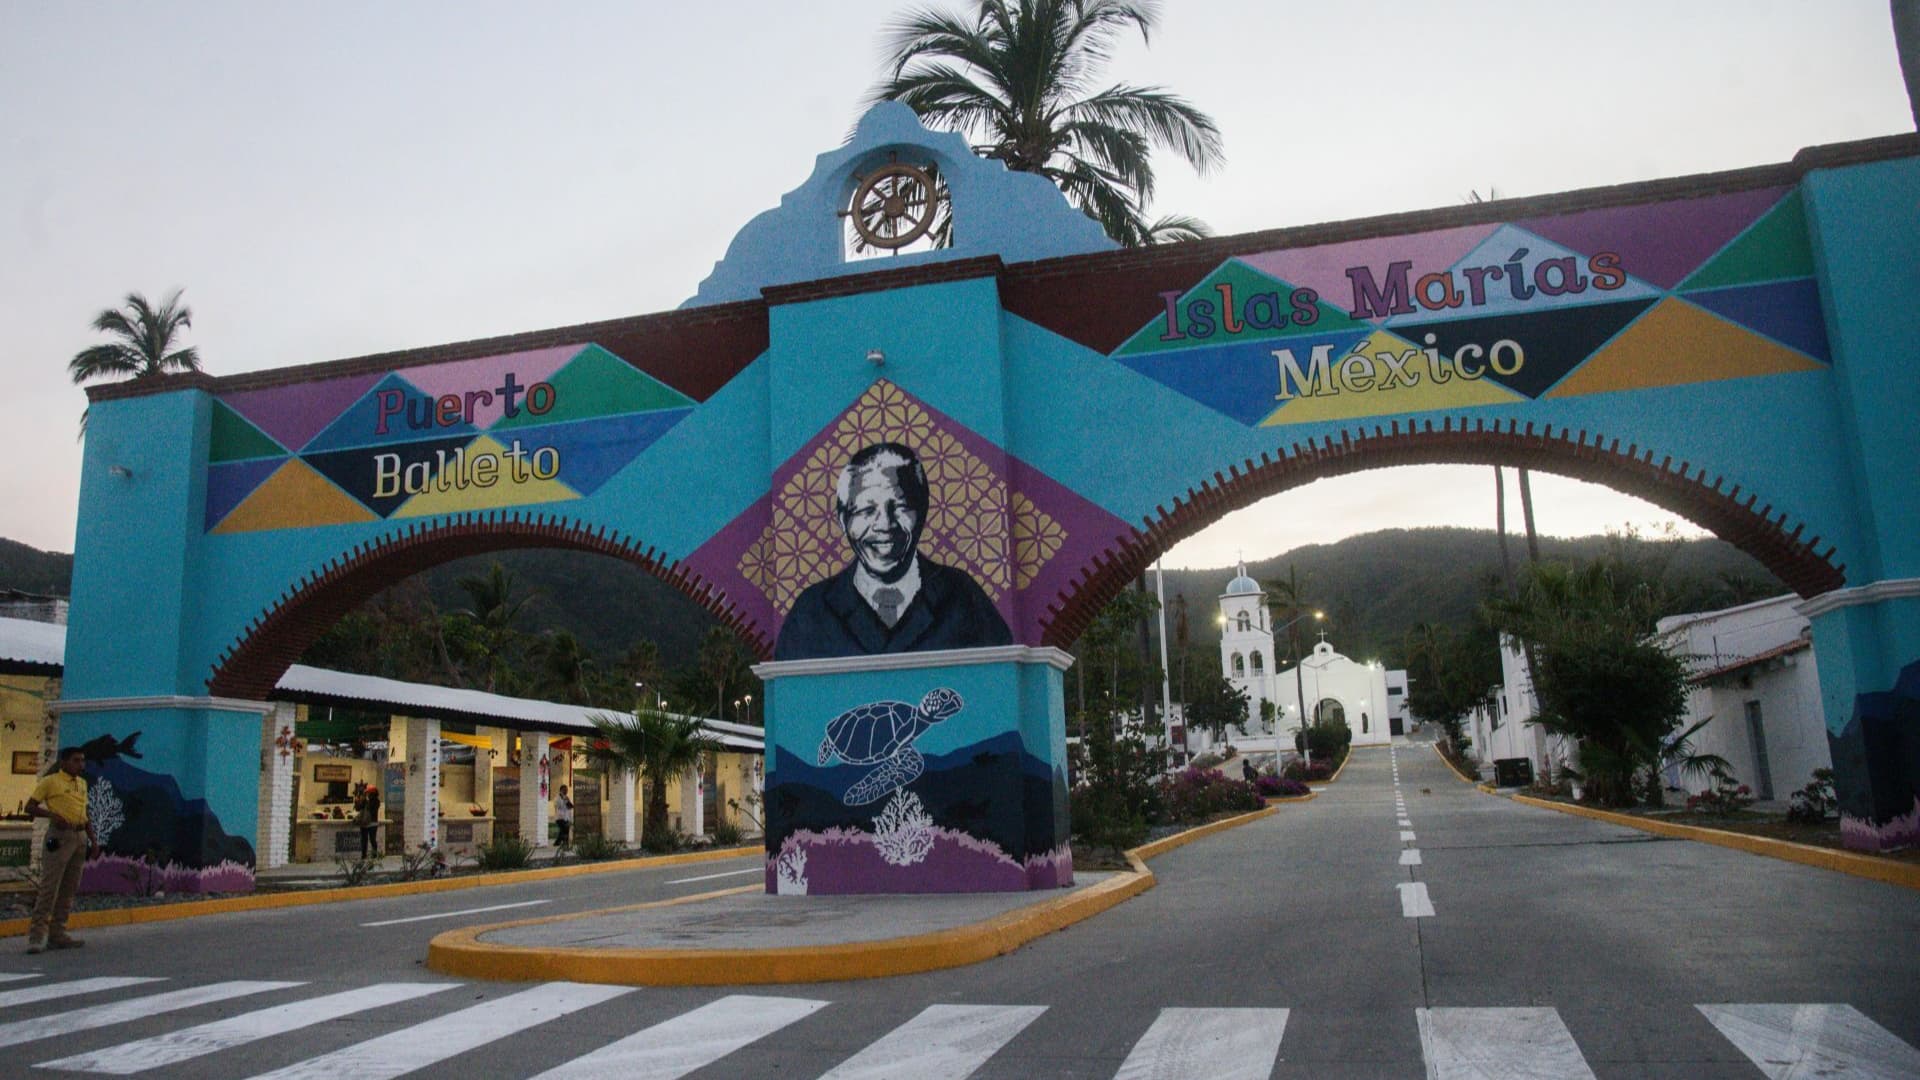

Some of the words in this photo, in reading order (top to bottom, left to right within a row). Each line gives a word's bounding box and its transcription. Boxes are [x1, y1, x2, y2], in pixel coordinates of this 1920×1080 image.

[1158, 283, 1320, 341] Islas
[1345, 248, 1627, 320] Marías
[1271, 332, 1525, 401] México
[374, 372, 556, 435] Puerto
[372, 440, 560, 498] Balleto
